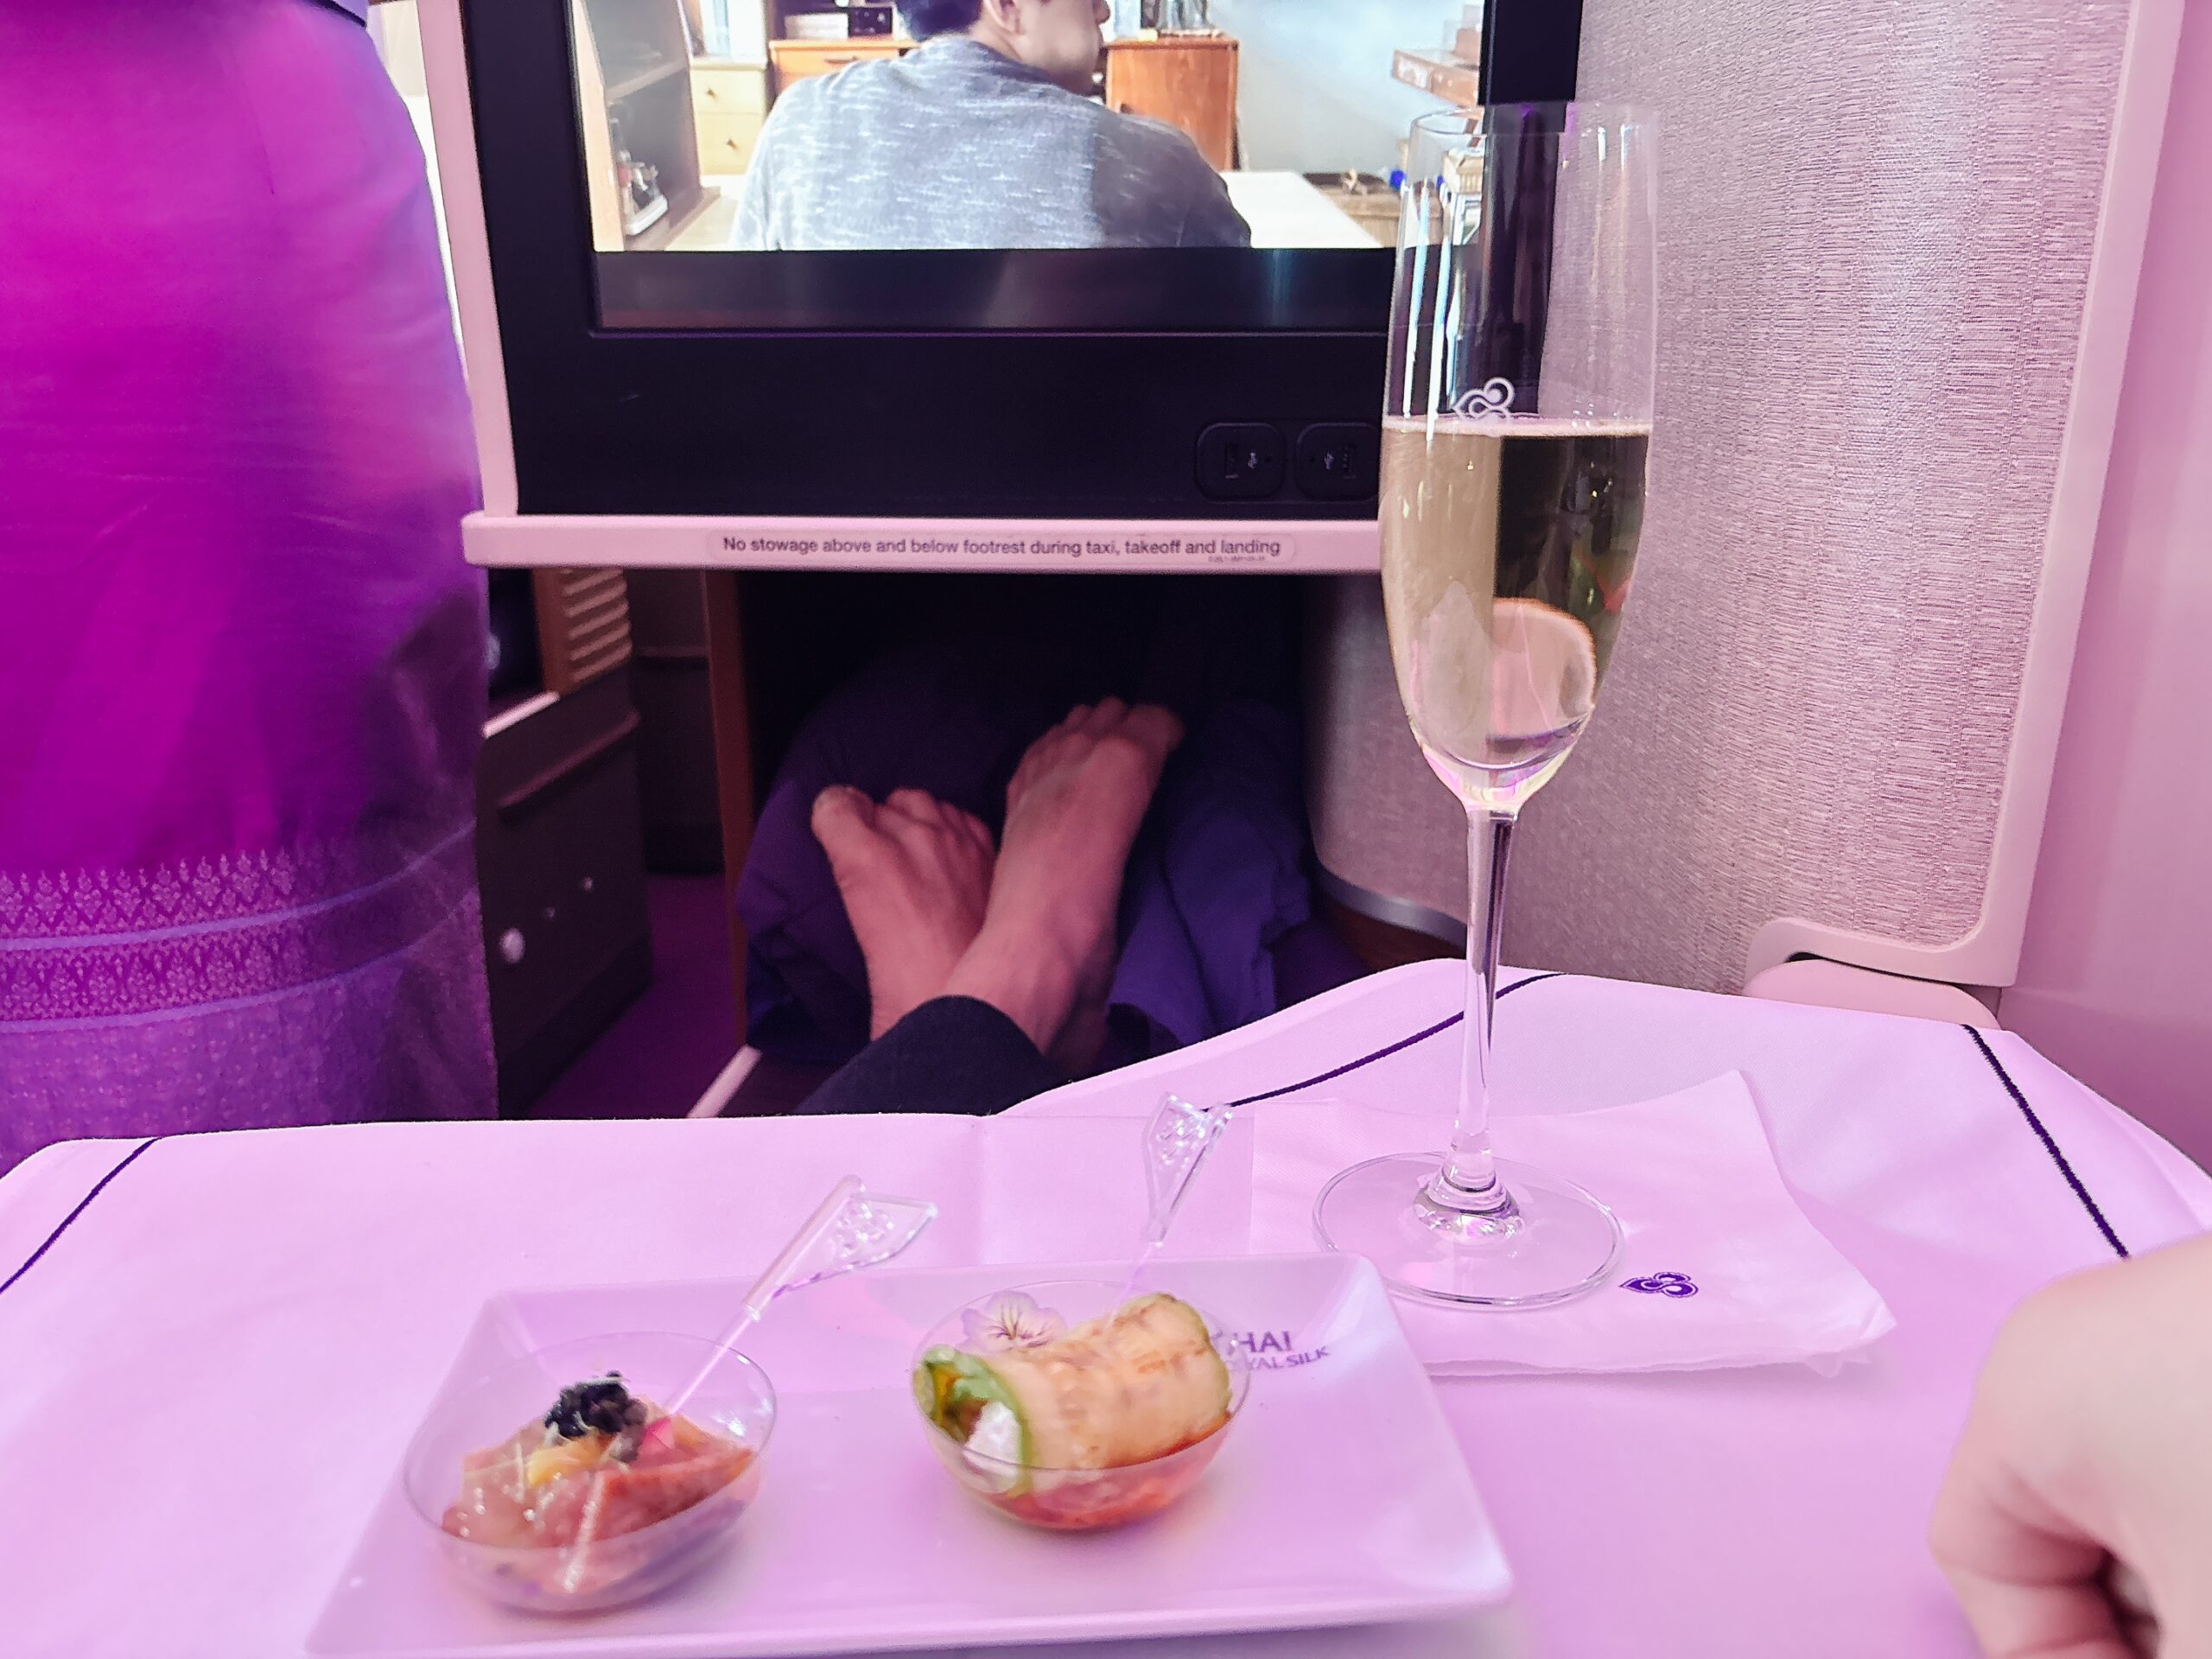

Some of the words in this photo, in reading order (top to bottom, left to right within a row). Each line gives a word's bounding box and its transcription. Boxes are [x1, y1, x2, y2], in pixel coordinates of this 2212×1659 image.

[723, 537, 746, 551] No
[750, 538, 818, 555] stowage
[823, 538, 871, 552] above
[876, 538, 906, 553] and
[911, 538, 958, 553] below
[963, 539, 1026, 554] footrest
[1030, 540, 1081, 557] during
[1086, 540, 1120, 556] taxi,
[1125, 540, 1180, 554] takeoff
[1185, 540, 1216, 554] and
[1221, 539, 1281, 556] landing
[1213, 1330, 1293, 1353] HAI
[1286, 1345, 1330, 1368] SILK
